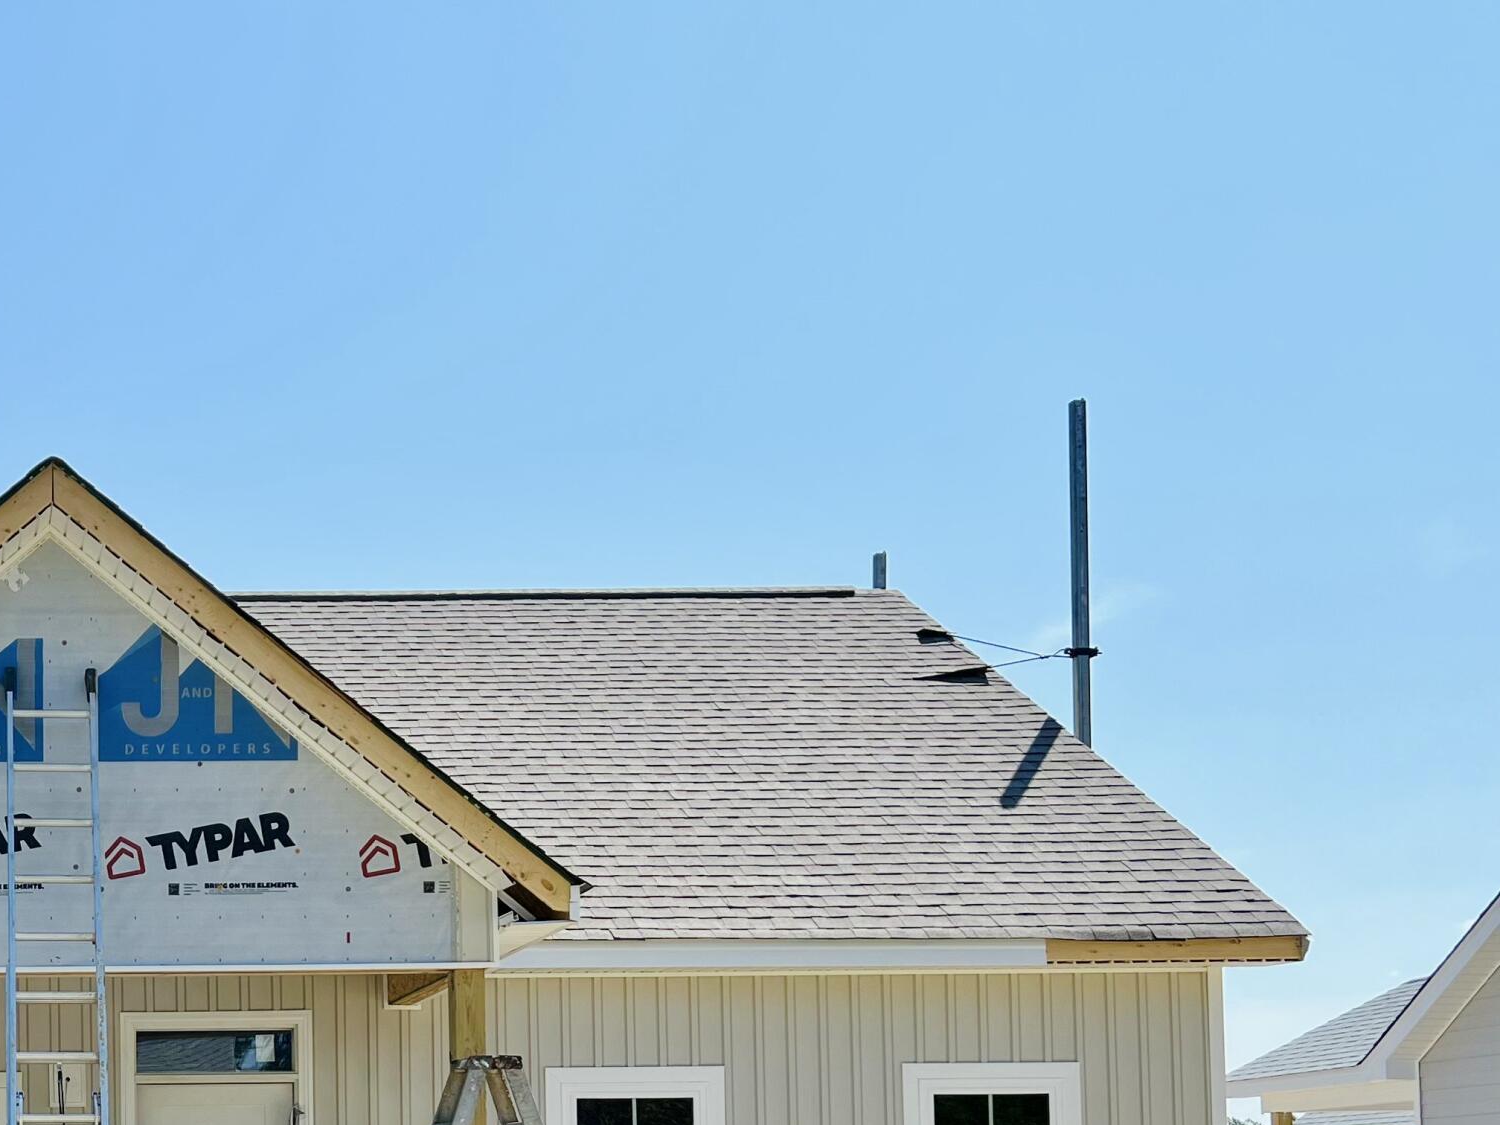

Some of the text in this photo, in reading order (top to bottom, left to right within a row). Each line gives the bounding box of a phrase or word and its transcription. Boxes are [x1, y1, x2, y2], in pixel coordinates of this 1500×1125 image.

[181, 687, 213, 699] AND
[124, 743, 271, 756] DEVELOPERS
[145, 812, 296, 870] TYPAR
